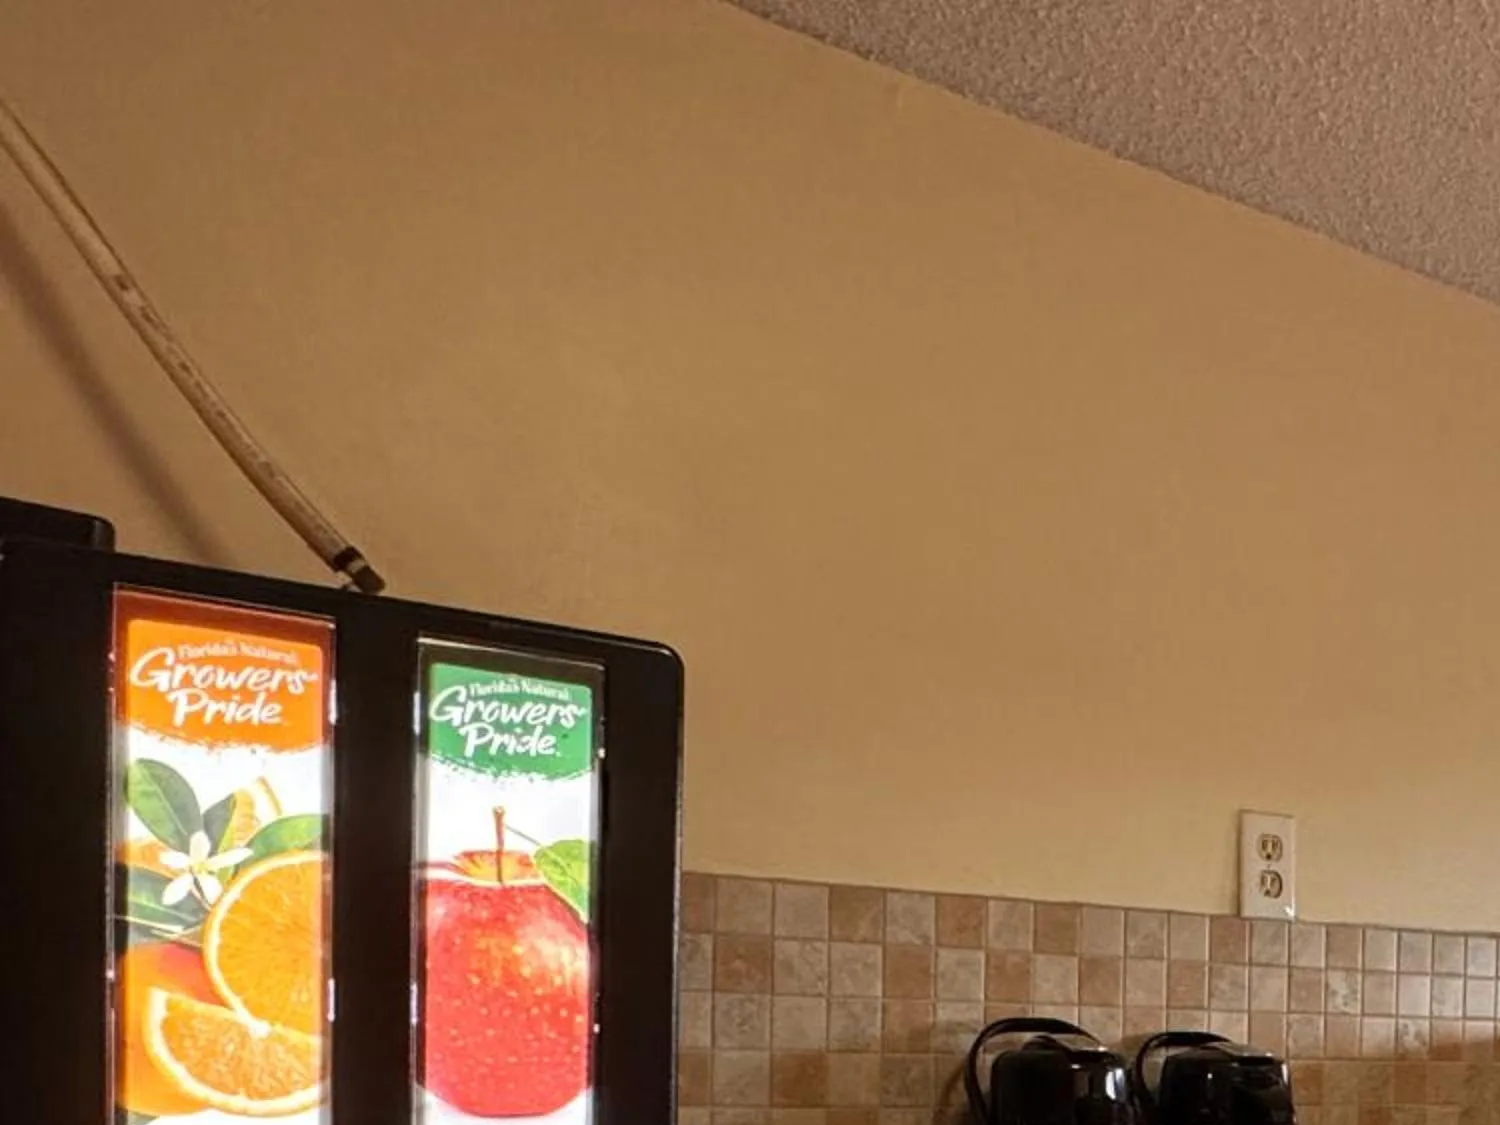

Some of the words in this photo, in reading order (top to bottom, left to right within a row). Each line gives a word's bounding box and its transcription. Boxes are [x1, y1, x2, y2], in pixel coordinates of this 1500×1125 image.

[129, 646, 318, 694] Growers
[166, 688, 283, 727] Pride
[430, 685, 588, 728] Growers
[458, 722, 558, 758] Pride
